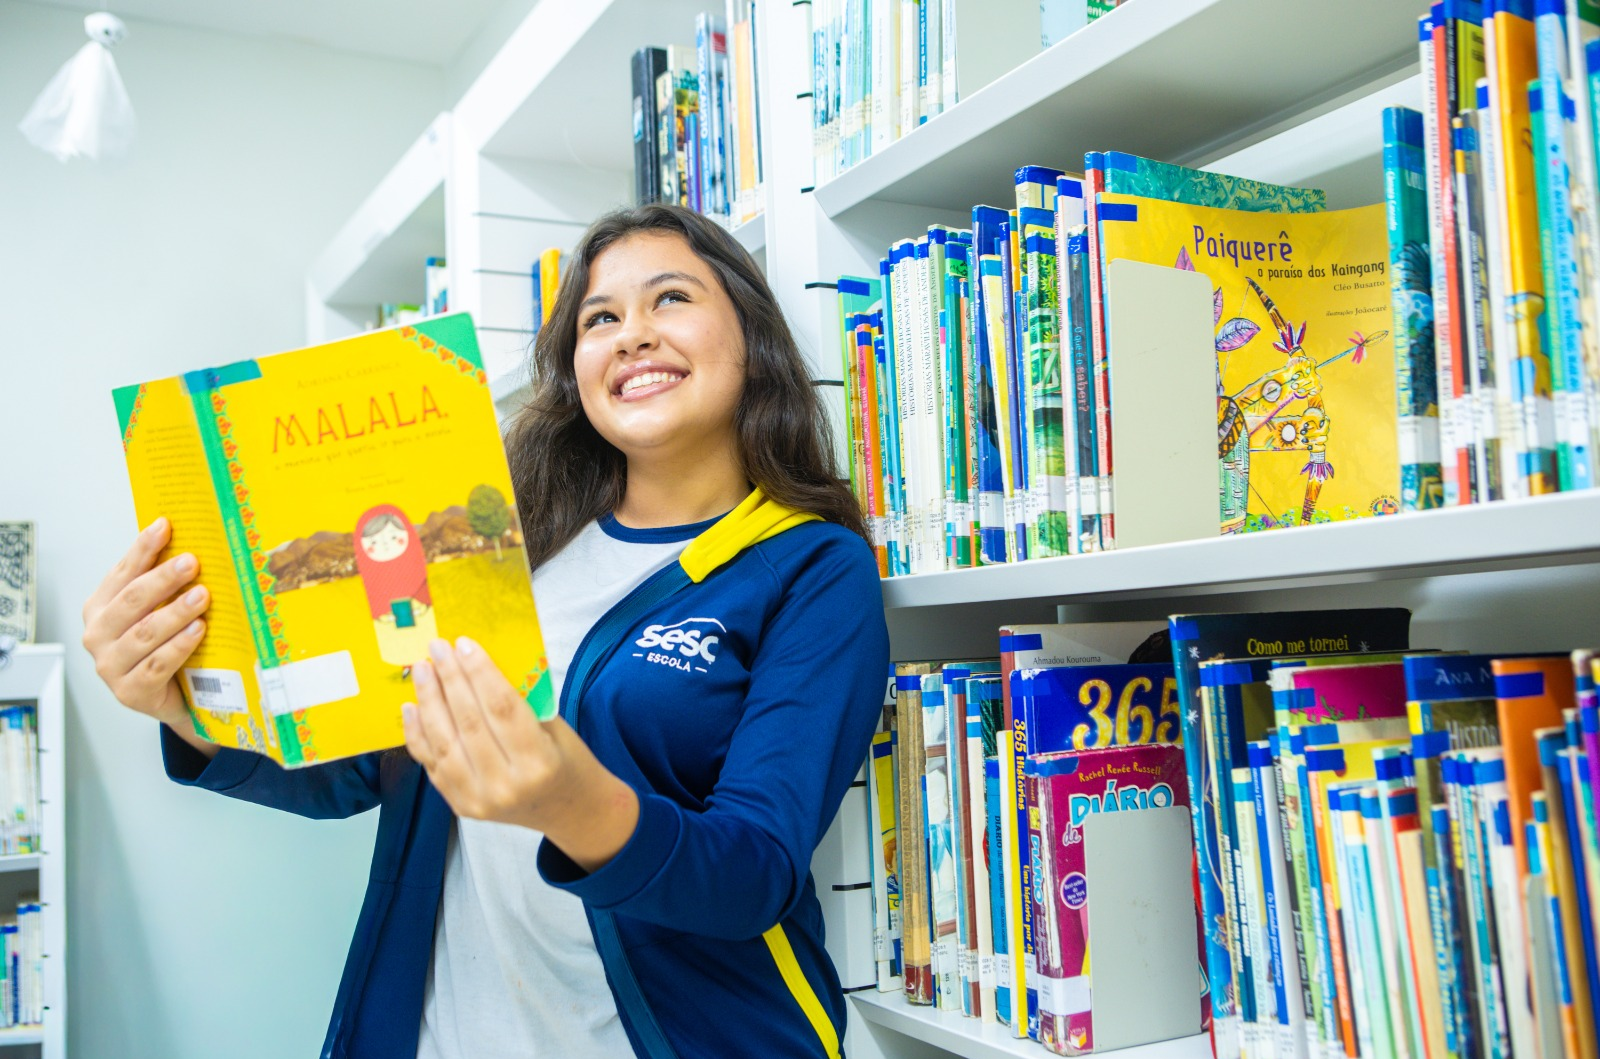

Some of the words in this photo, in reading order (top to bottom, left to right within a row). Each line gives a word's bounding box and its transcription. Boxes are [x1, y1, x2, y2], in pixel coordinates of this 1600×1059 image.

[1193, 225, 1293, 268] Paiquerê
[1257, 269, 1264, 278] o
[1268, 264, 1303, 281] paraíso
[1308, 265, 1326, 278] dos
[1331, 260, 1385, 281] Kaingang
[1333, 283, 1352, 292] Cléo
[1354, 279, 1385, 291] Busatto
[895, 301, 902, 312] DE
[903, 295, 909, 308] DE
[921, 294, 928, 306] DE
[895, 313, 906, 374] MARAVILHOSAS
[903, 308, 914, 371] MARAVILHOSAS
[921, 306, 932, 370] MARAVILHOSAS
[1073, 334, 1083, 350] que
[898, 375, 909, 420] HISTÓRIAS
[906, 372, 917, 416] HISTÓRIAS
[923, 371, 935, 415] HISTÓRIAS
[1073, 366, 1091, 413] saber?
[1247, 638, 1283, 656] Como
[1287, 640, 1306, 653] me
[1309, 635, 1349, 653] tornei
[646, 652, 691, 673] ESCOLA
[1033, 656, 1065, 666] Ahmadou
[1066, 655, 1102, 664] Kourouma
[1072, 677, 1182, 750] 365
[1012, 717, 1027, 753] 365
[1445, 718, 1499, 750] HISTÓR
[1015, 755, 1027, 810] Histórias
[1079, 766, 1105, 783] Rachel
[1106, 761, 1130, 775] Renée
[1133, 761, 1161, 777] Russell
[1070, 779, 1174, 828] DIÁRIO
[1062, 824, 1082, 847] de
[997, 849, 1003, 859] de
[1022, 864, 1030, 884] Uma
[1023, 885, 1032, 922] história
[1023, 922, 1033, 942] por
